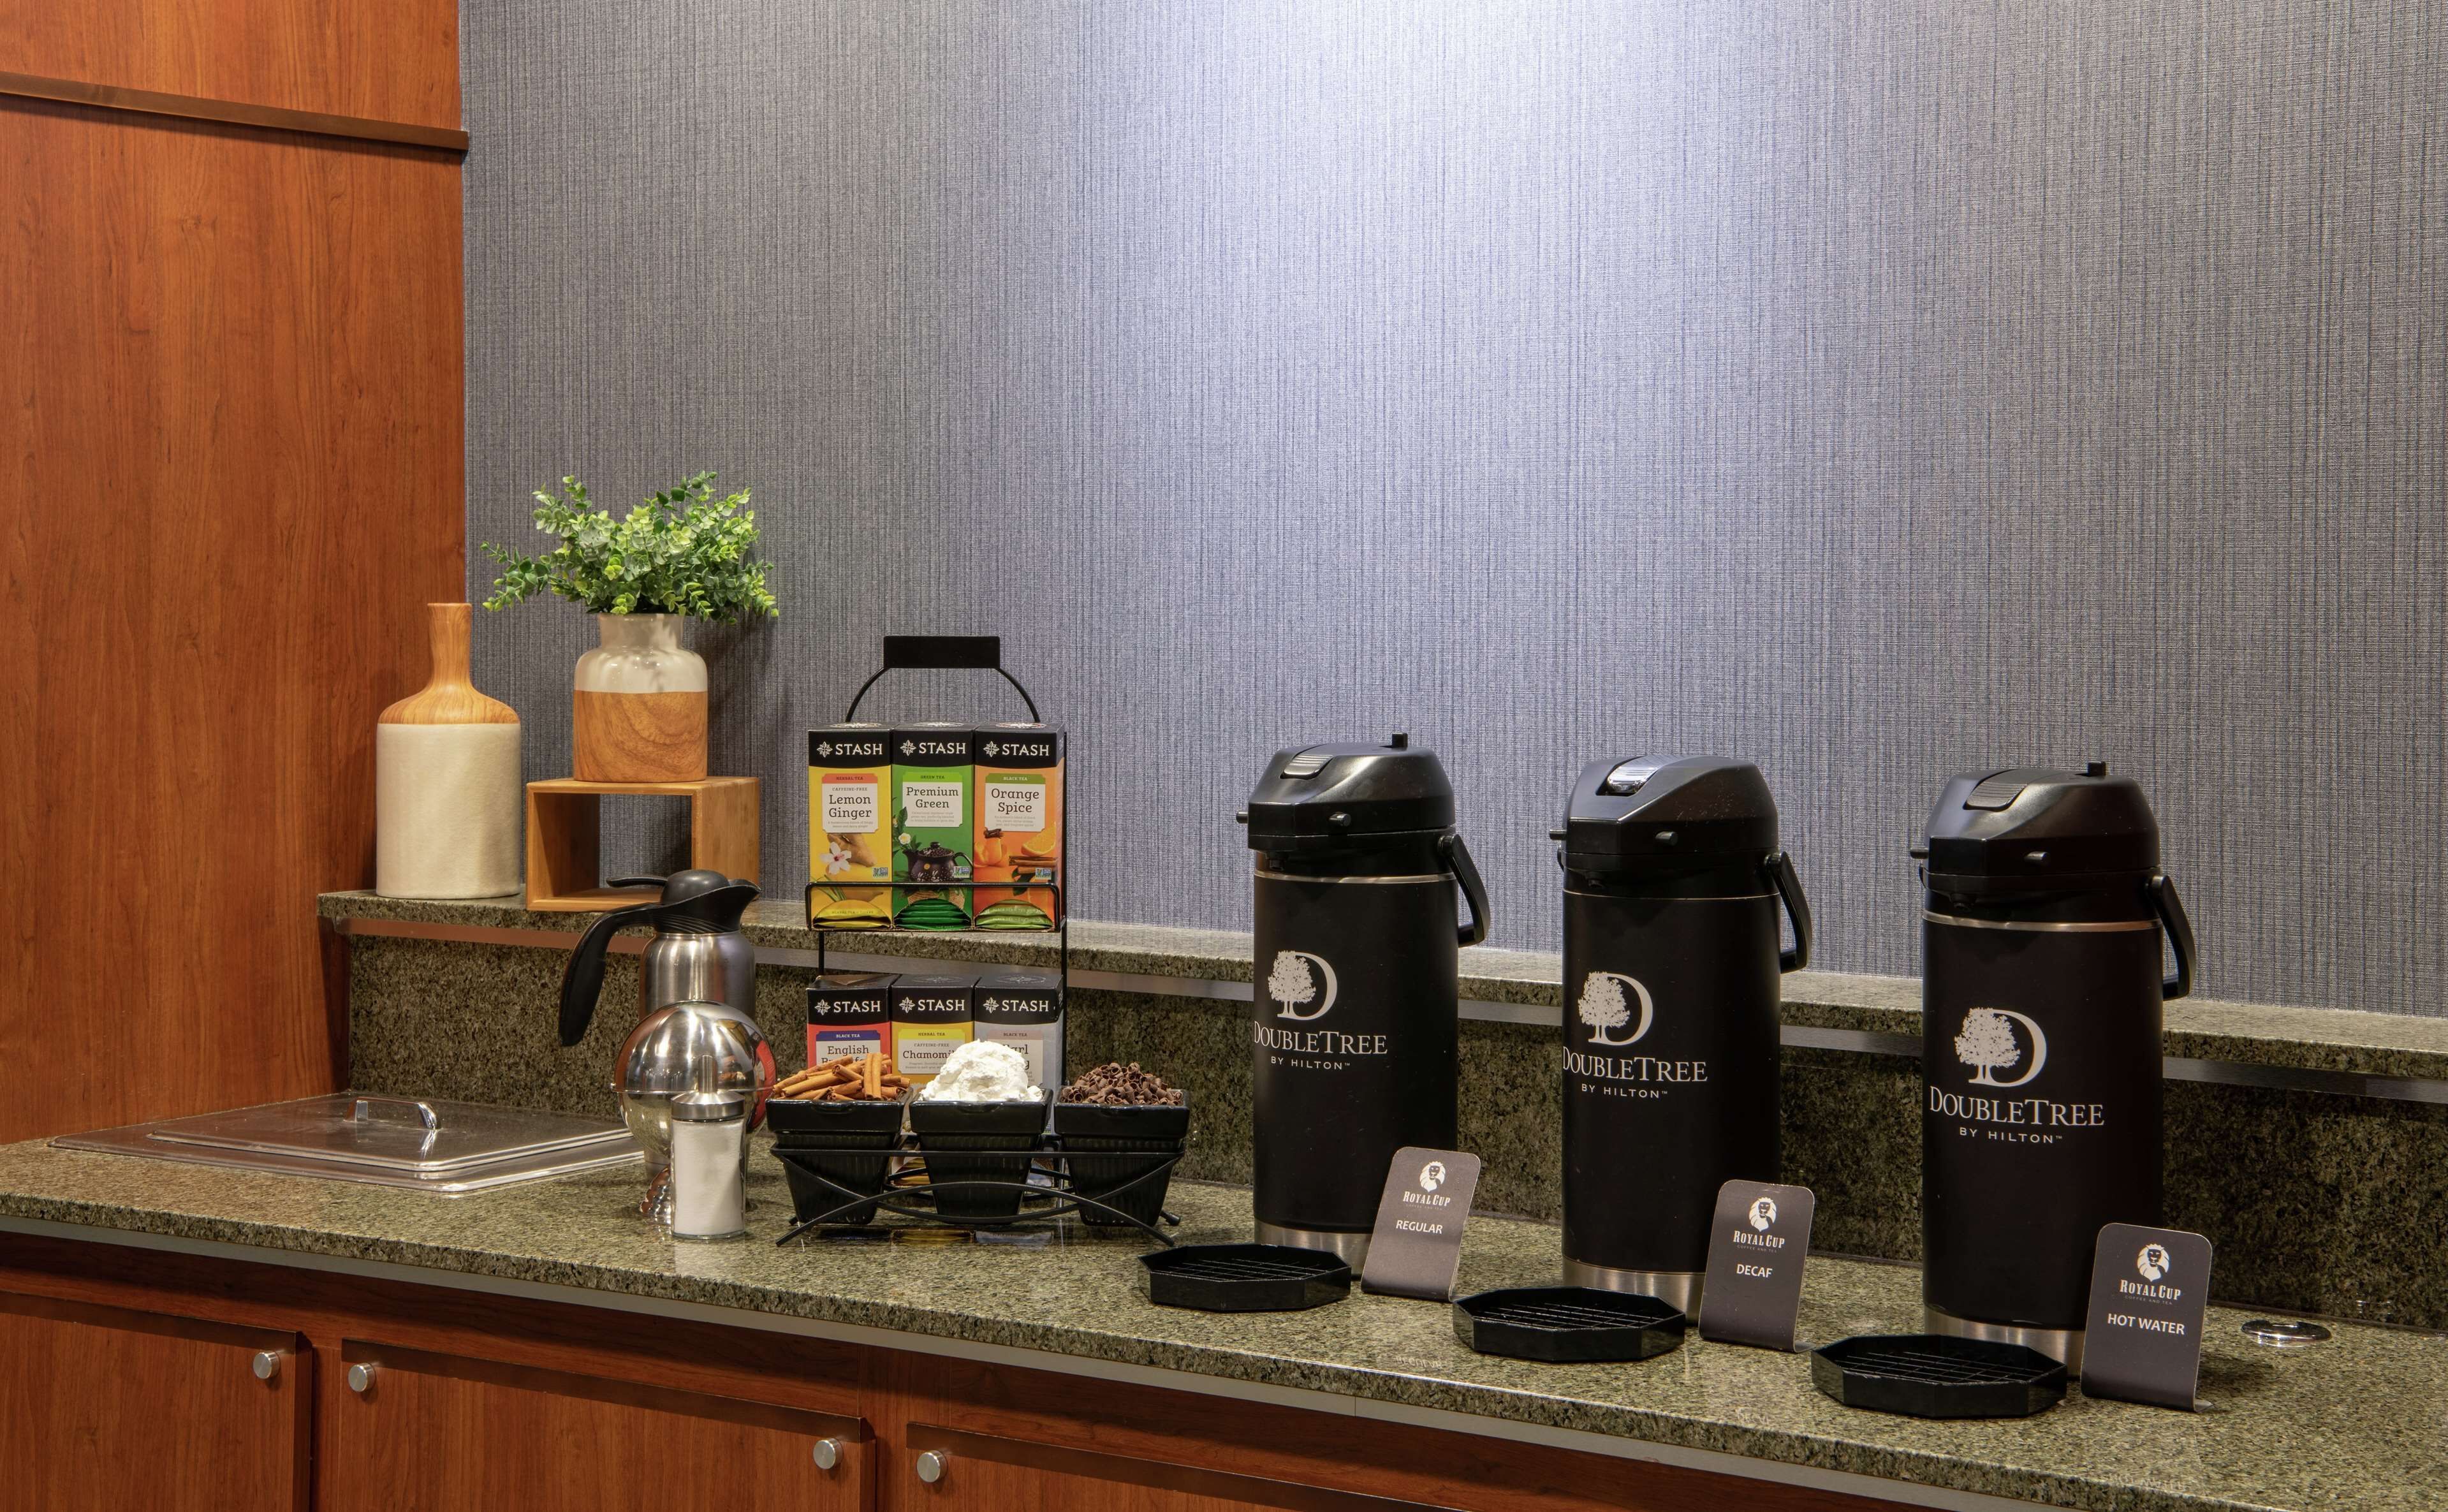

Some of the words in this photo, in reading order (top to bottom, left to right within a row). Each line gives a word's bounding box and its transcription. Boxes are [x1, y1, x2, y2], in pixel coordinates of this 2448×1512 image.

[835, 743, 883, 755] STASH
[918, 742, 966, 754] STASH
[1002, 744, 1050, 756] STASH
[906, 786, 958, 796] Premium
[991, 788, 1039, 802] Orange
[829, 795, 871, 804] Lemon
[916, 799, 949, 808] Green
[829, 807, 872, 820] Ginger
[998, 802, 1032, 815] Spice
[833, 1000, 881, 1013] STASH
[918, 999, 965, 1011] STASH
[1002, 1000, 1049, 1012] STASH
[828, 1045, 869, 1057] English
[903, 1050, 955, 1059] Chamomi
[1002, 1044, 1029, 1054] arl
[1271, 1056, 1284, 1065] BY
[1581, 1083, 1595, 1093] BY
[1960, 1127, 1977, 1137] BY
[1403, 1191, 1432, 1205] ROYAL
[1432, 1194, 1451, 1207] CUP
[1396, 1220, 1443, 1235] REGULAR
[1733, 1230, 1764, 1246] ROYAL
[1766, 1235, 1785, 1248] CUP
[1736, 1264, 1773, 1278] DECAF
[2120, 1279, 2157, 1297] ROYAL
[2158, 1285, 2181, 1300] CUP
[2107, 1313, 2136, 1327] HOT
[2138, 1317, 2185, 1335] WATER
